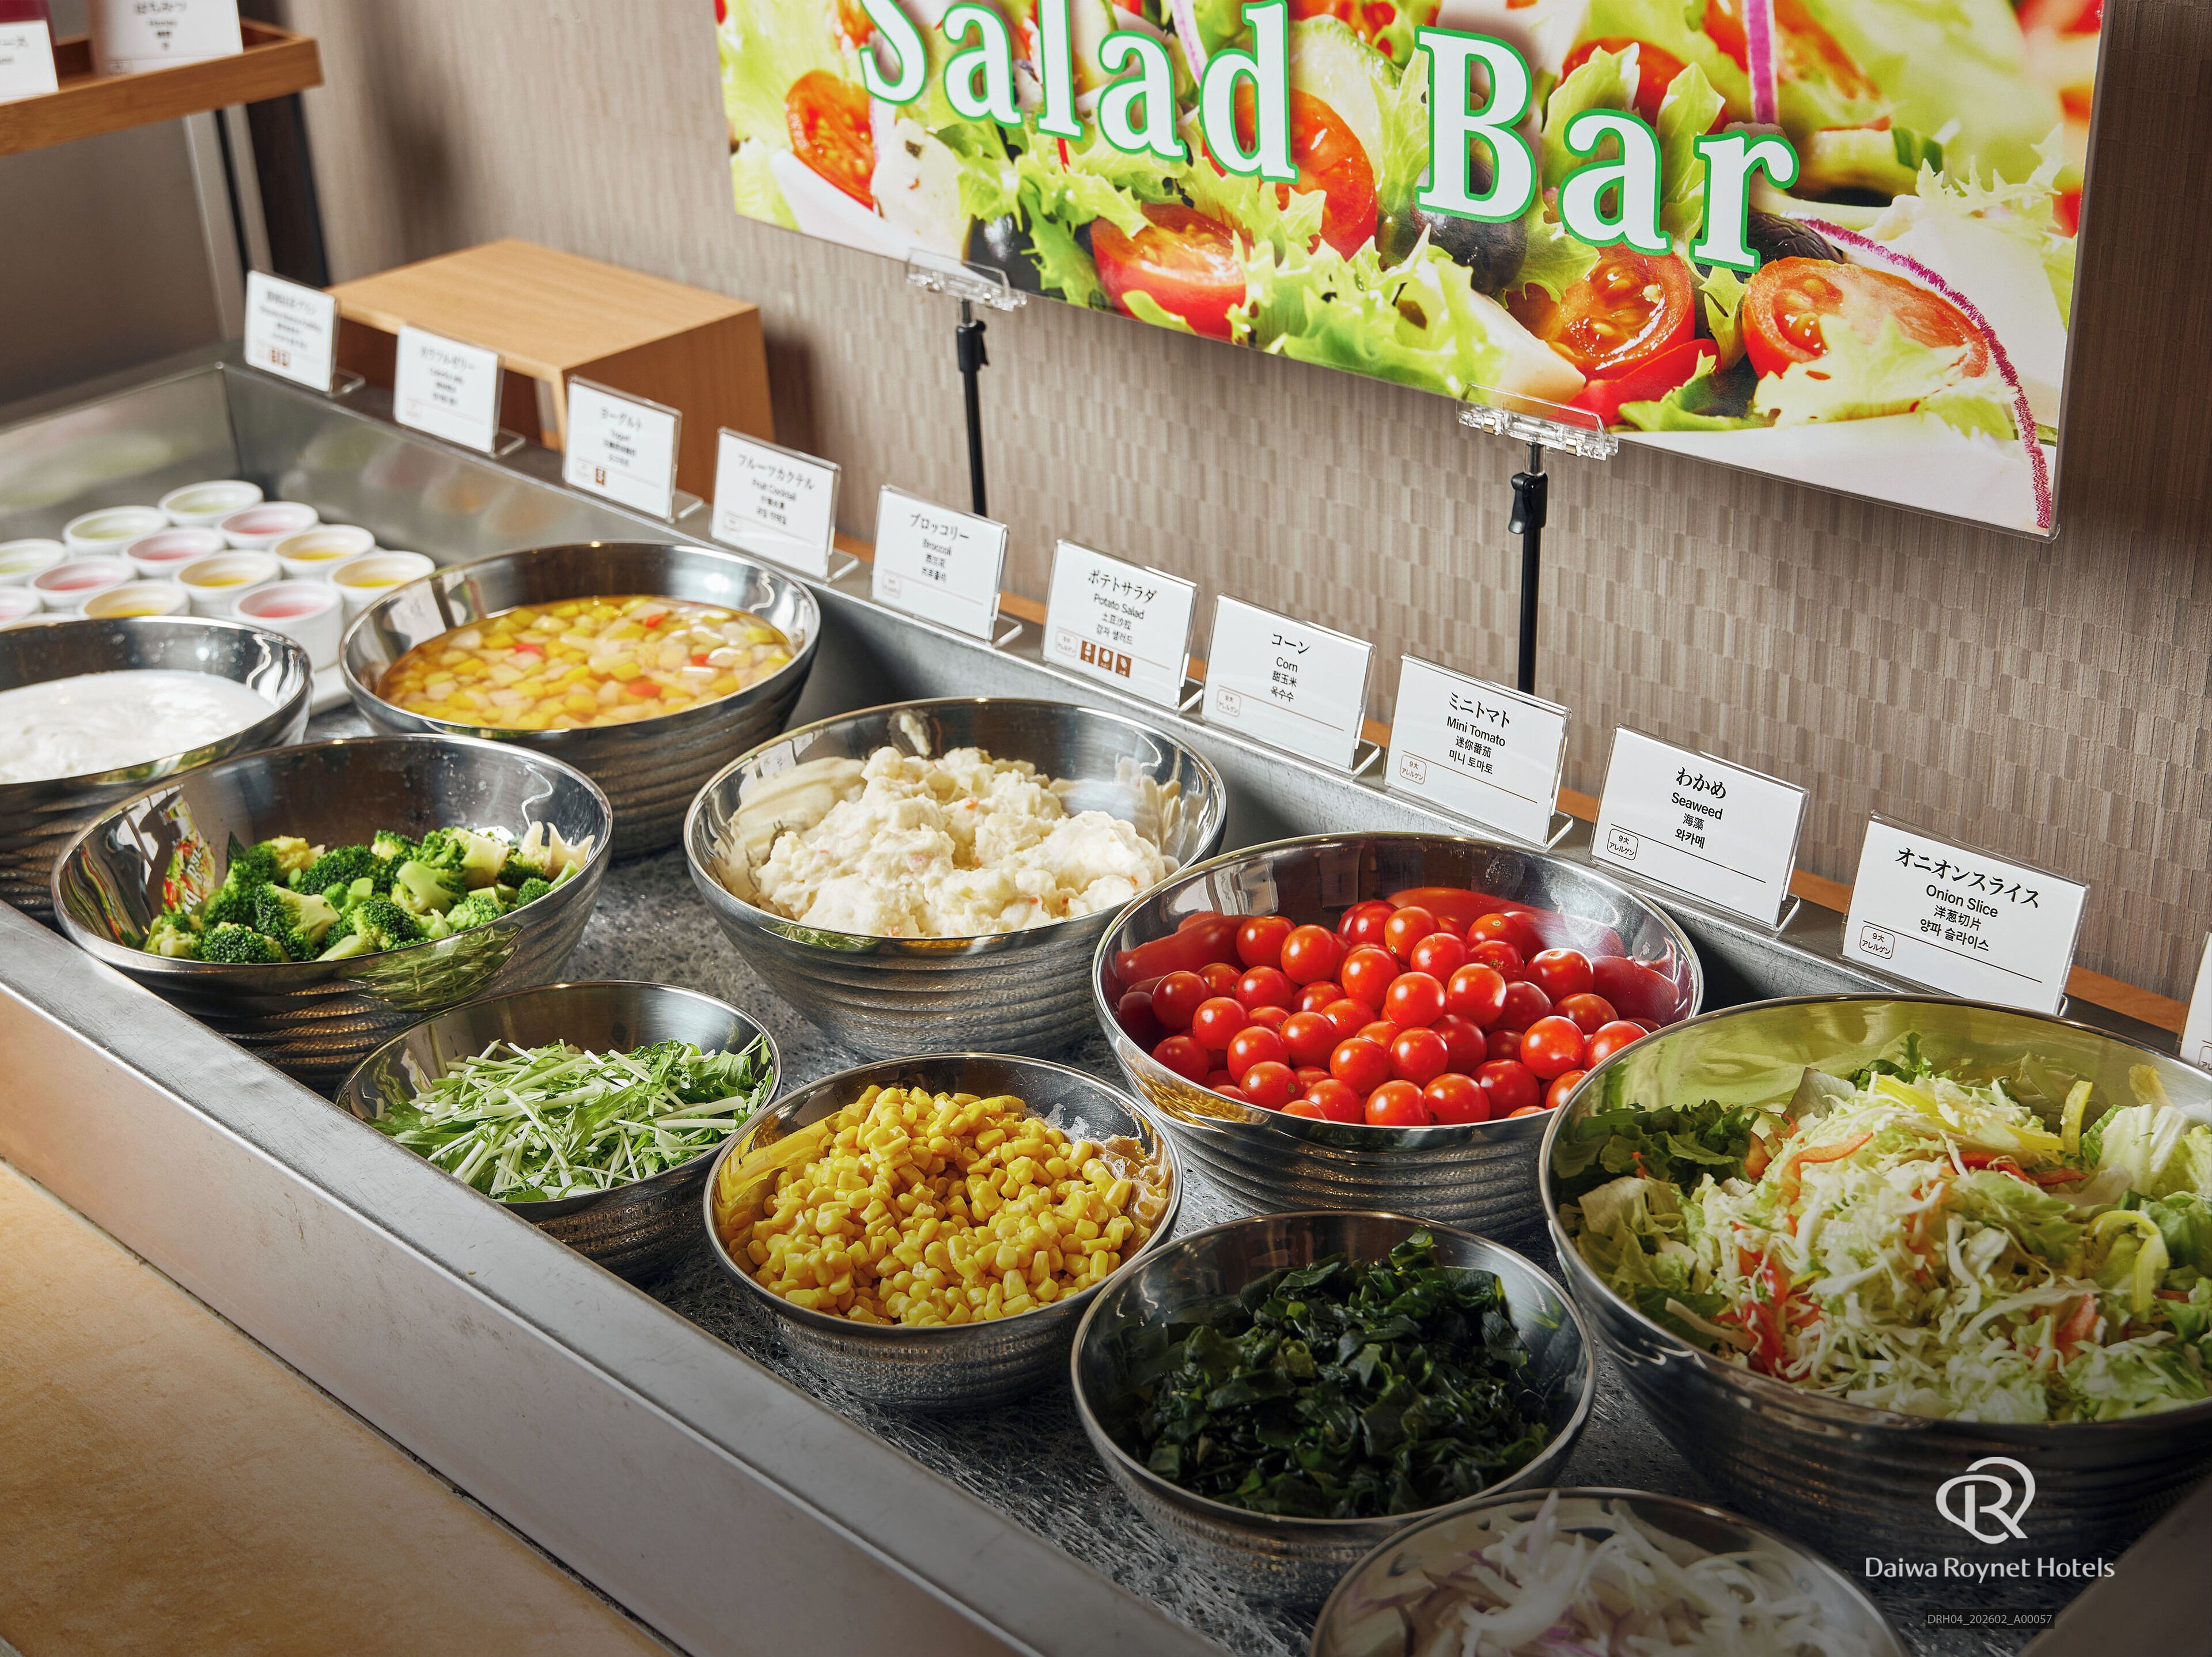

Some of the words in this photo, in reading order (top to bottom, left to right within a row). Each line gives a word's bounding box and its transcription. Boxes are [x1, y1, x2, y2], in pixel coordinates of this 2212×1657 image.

[859, 0, 1300, 184] Salad
[1414, 25, 1799, 273] Bar
[738, 453, 815, 490] フルーツカクテル
[910, 513, 969, 540] ブロッコリー
[1088, 570, 1157, 604] ポテトサラダ
[1093, 593, 1120, 611] Potato
[1121, 603, 1145, 620] Salad
[1271, 633, 1311, 655] コーン
[1276, 656, 1298, 673] Corn
[1271, 686, 1294, 703] 옥수수
[1449, 691, 1510, 728] ミニトマト
[1446, 716, 1468, 733] Mini
[1469, 724, 1506, 747] Tomato
[1455, 735, 1492, 758] 迷你番茄
[1402, 767, 1424, 780] アレルゲン
[1409, 761, 1419, 770] 9大
[1449, 749, 1466, 766] 미니
[1467, 756, 1493, 774] 토마토
[1676, 767, 1726, 799] わかめ
[1671, 792, 1724, 820] Seaweed
[1682, 813, 1705, 831] 海藻
[1609, 842, 1635, 856] アレルゲン
[1618, 835, 1630, 845] 9大
[1675, 828, 1706, 849] 와카메
[1895, 847, 2040, 909] オニオンスライス
[1926, 884, 1964, 907] Onion
[1966, 897, 1999, 918] Slice
[1933, 905, 1982, 932] 洋葱切片
[1862, 940, 1891, 954] アレルゲン
[1872, 932, 1885, 943] 9大
[1920, 918, 1942, 937] 양파
[1944, 927, 1990, 952] 슬라이스
